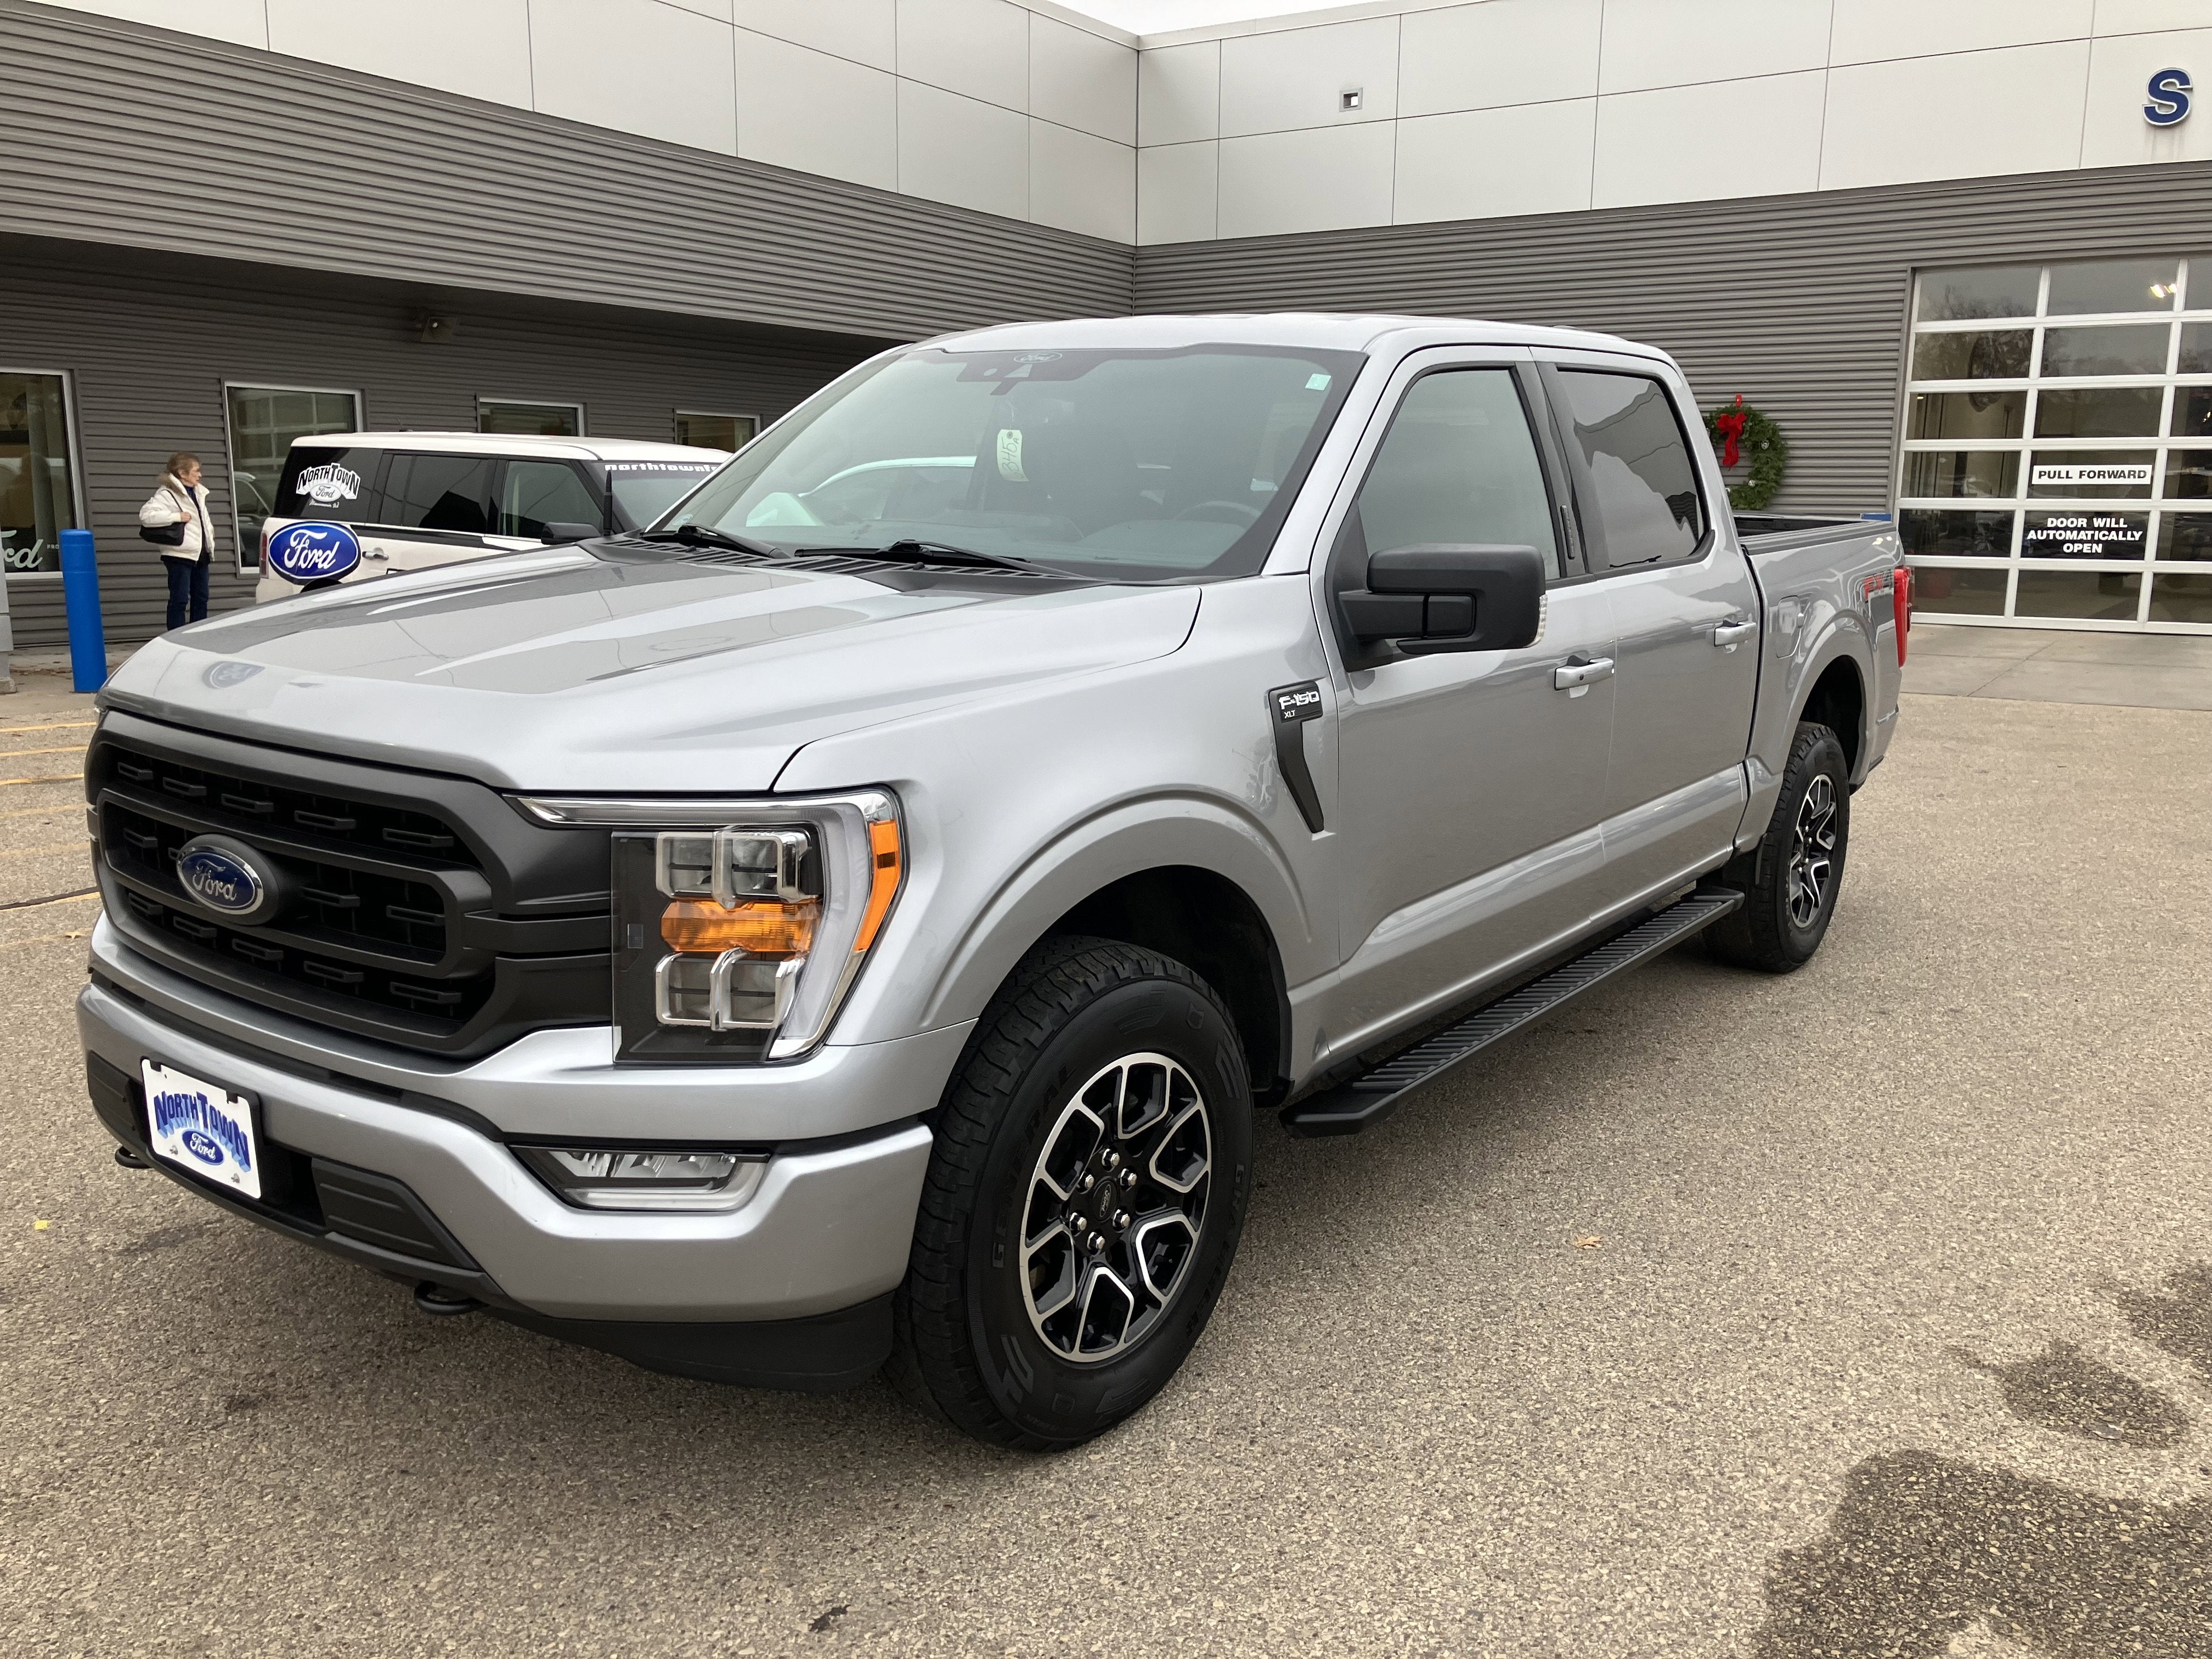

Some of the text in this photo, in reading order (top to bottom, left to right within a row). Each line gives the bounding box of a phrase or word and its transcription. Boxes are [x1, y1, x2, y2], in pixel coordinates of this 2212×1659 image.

[2142, 67, 2193, 127] S
[2038, 470, 2147, 479] PULL FORWARD
[316, 486, 335, 498] Ford
[2047, 518, 2128, 527] DOOR WILL
[2027, 530, 2143, 540] AUTOMATICALLY
[284, 529, 340, 569] Ford
[2063, 543, 2102, 553] OPEN
[1278, 691, 1319, 709] F-150
[1284, 710, 1295, 719] XLT
[193, 859, 238, 901] Ford
[190, 1132, 216, 1160] Ford
